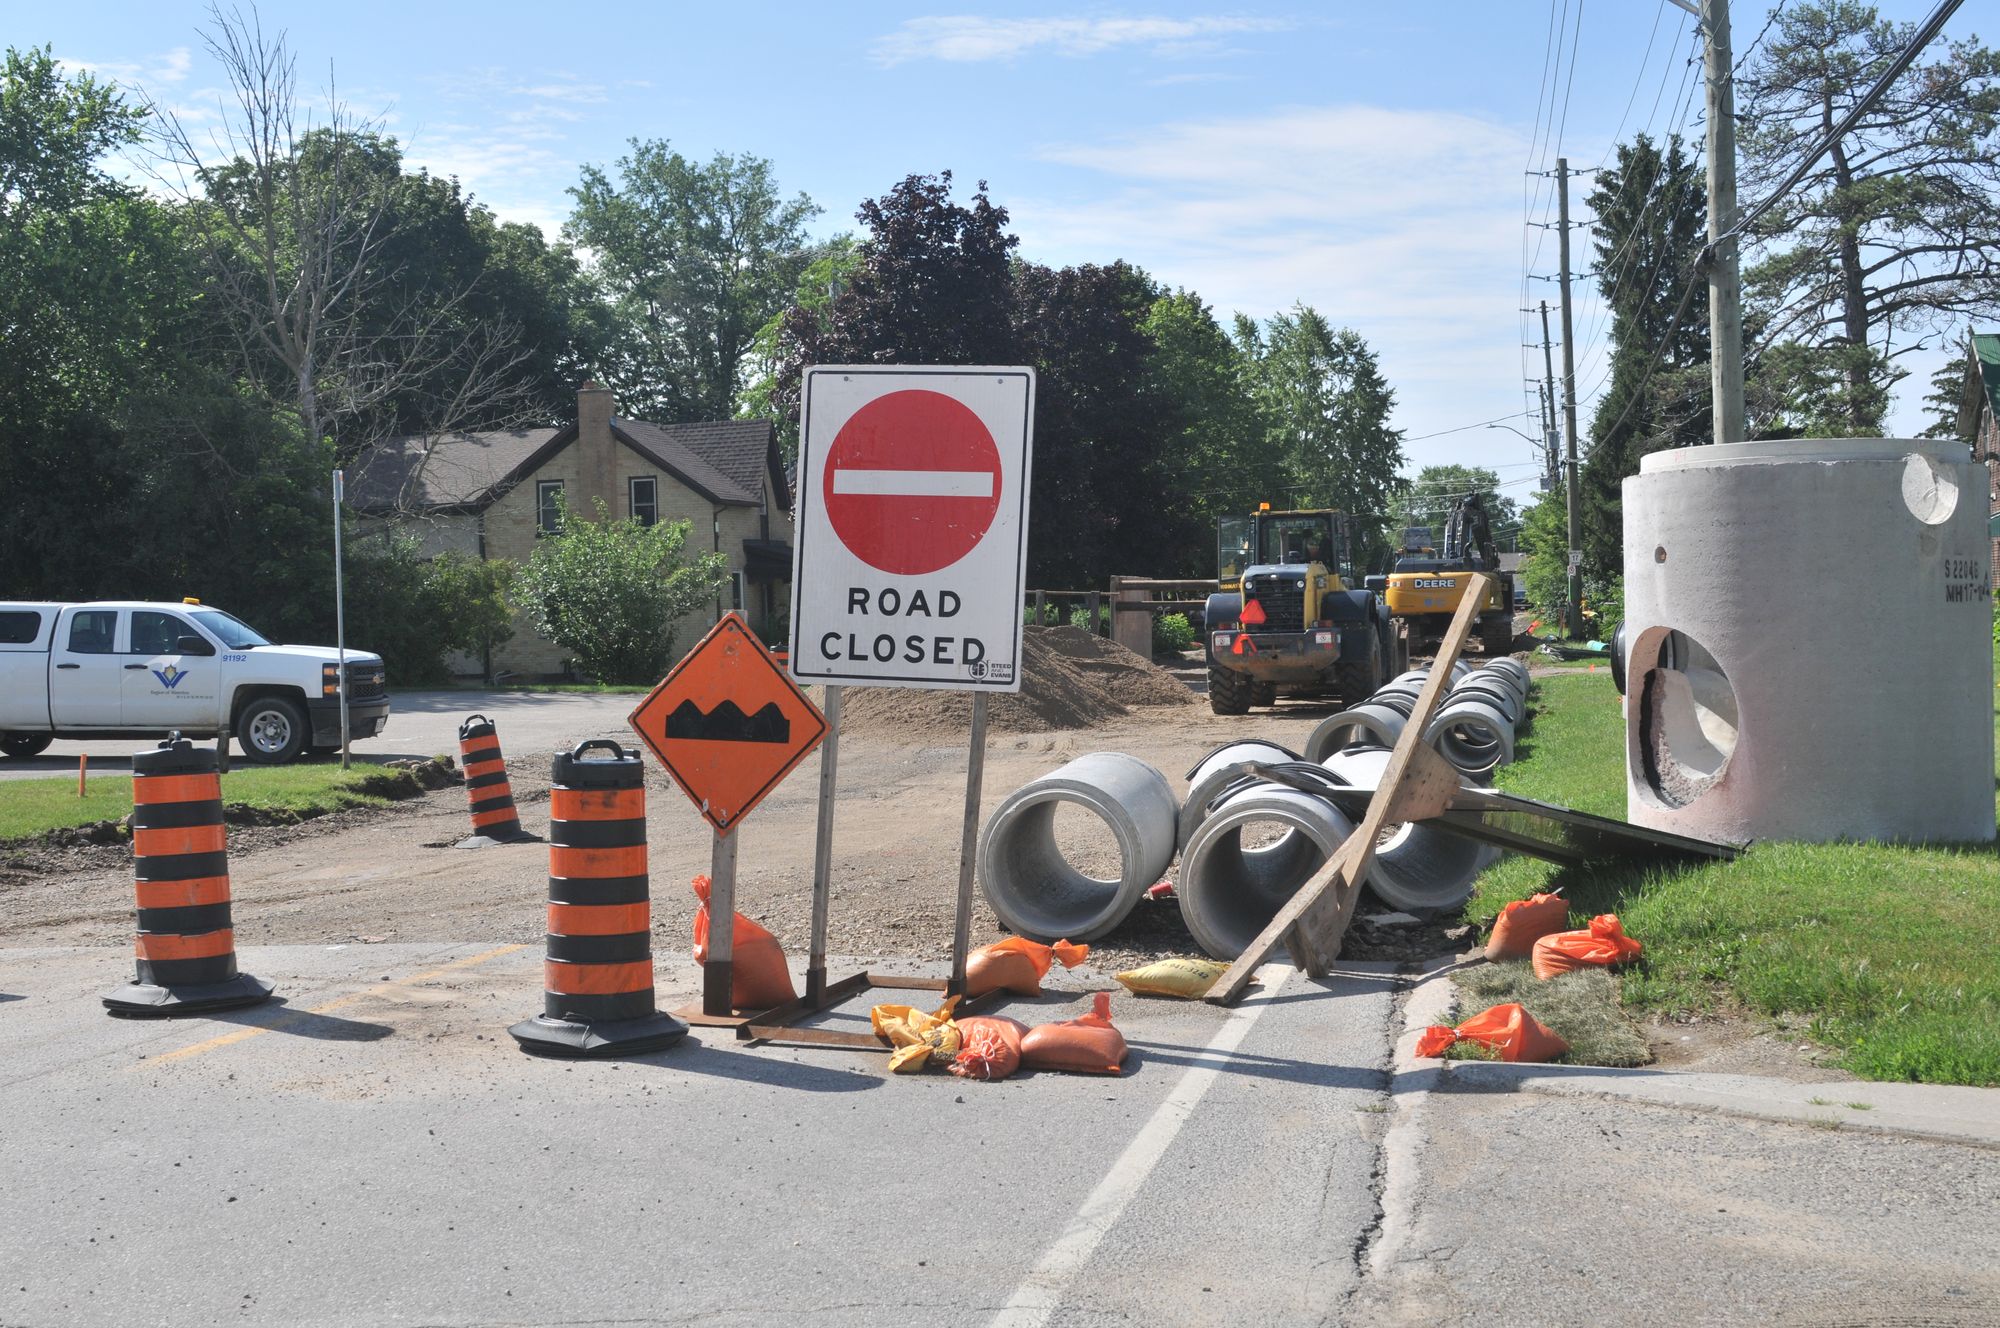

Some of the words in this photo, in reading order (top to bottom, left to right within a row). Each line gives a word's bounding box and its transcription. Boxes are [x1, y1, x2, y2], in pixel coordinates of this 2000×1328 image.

[1414, 578, 1456, 588] DEERE
[848, 587, 962, 617] ROAD
[222, 654, 247, 662] 91192
[820, 631, 986, 665] CLOSED
